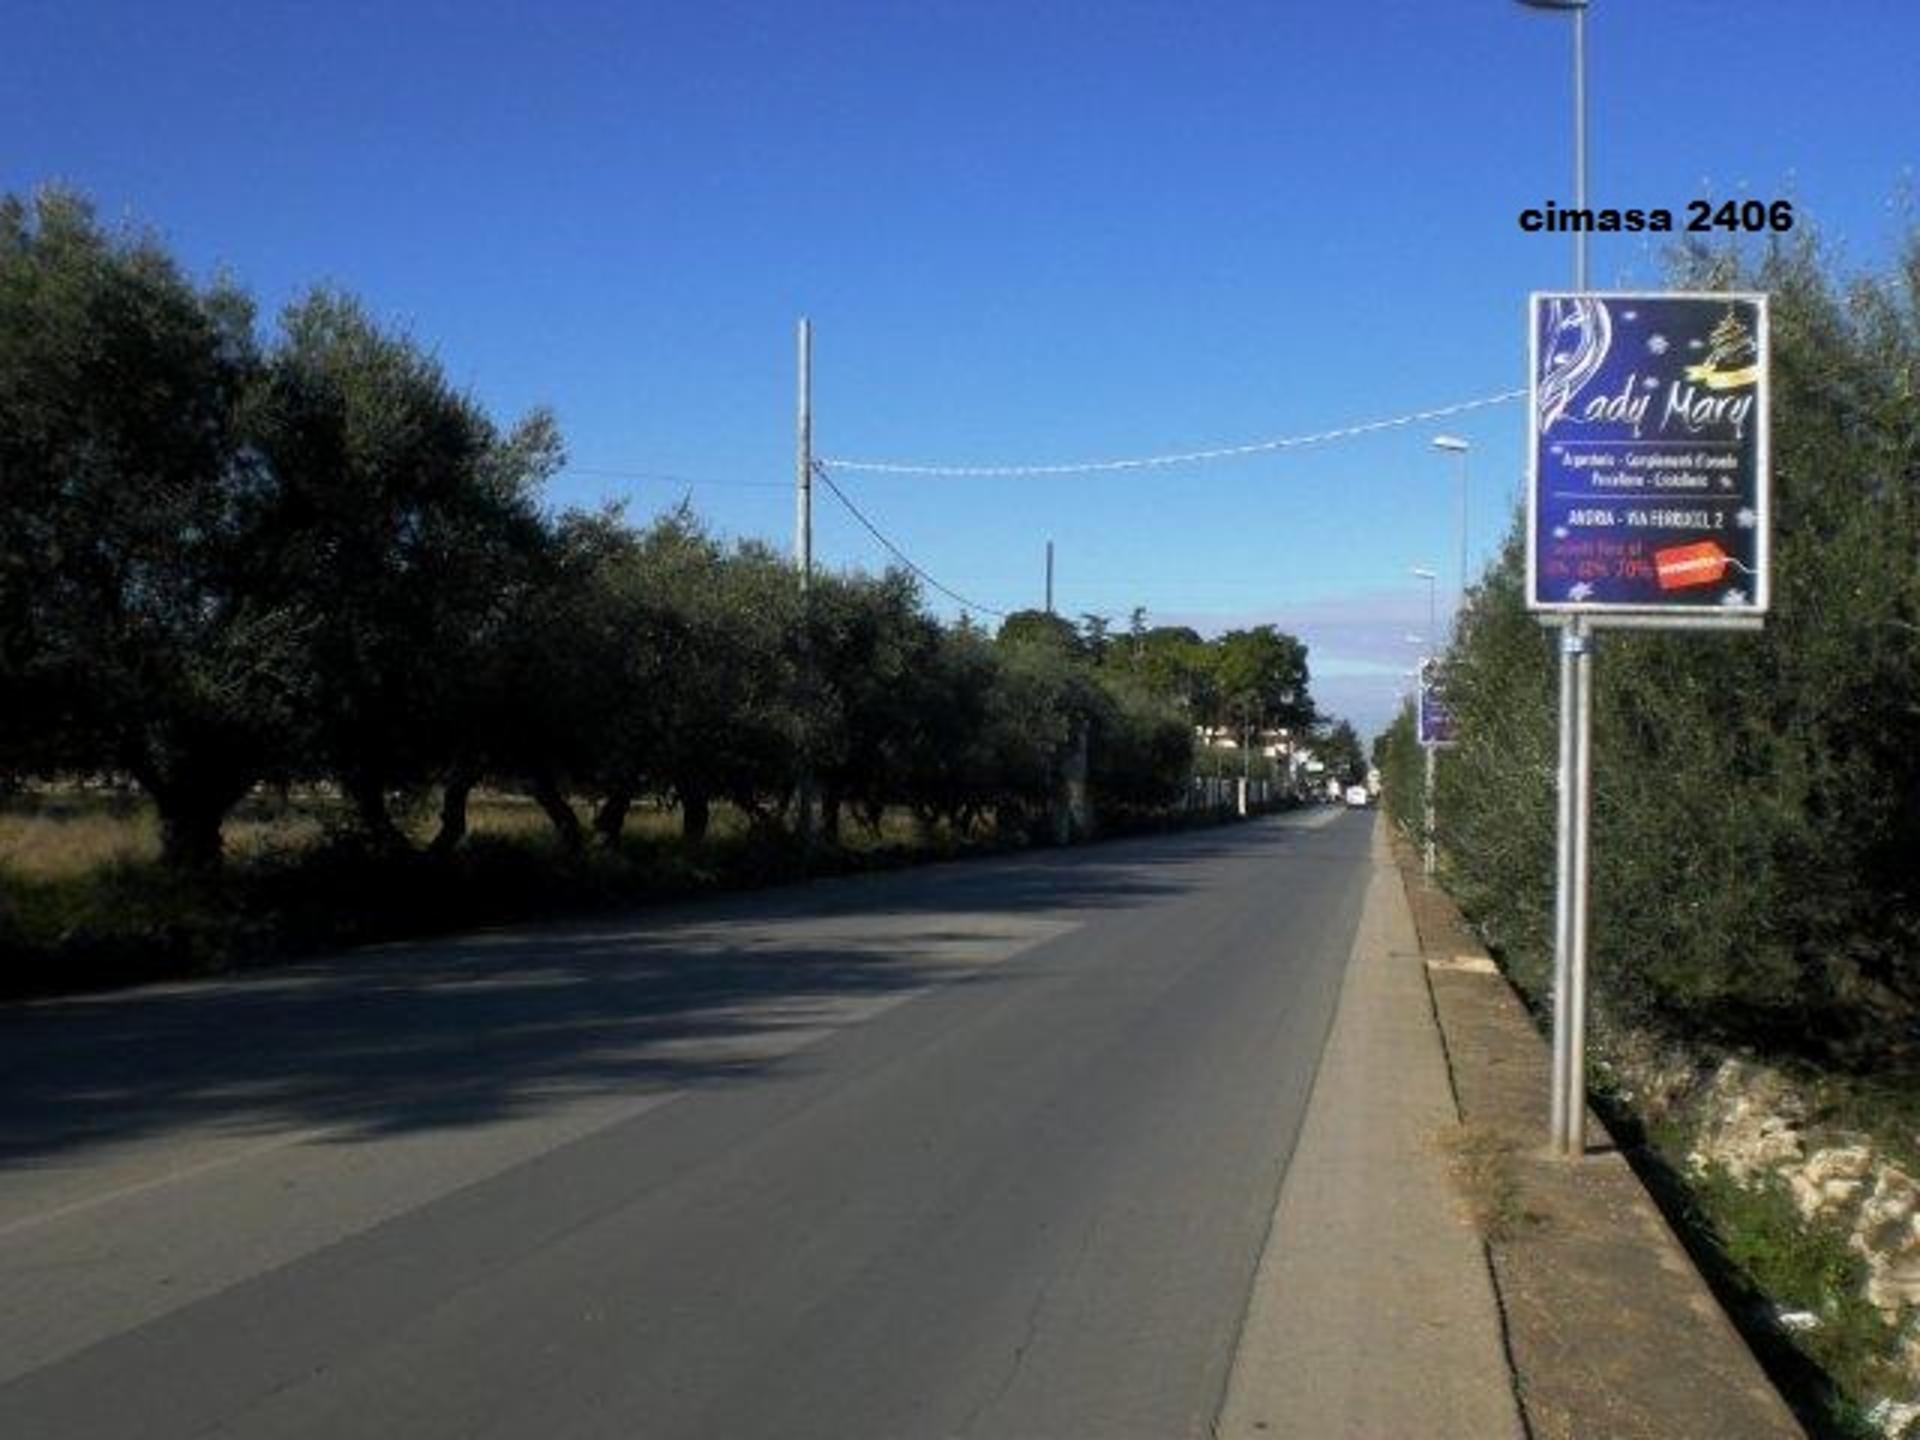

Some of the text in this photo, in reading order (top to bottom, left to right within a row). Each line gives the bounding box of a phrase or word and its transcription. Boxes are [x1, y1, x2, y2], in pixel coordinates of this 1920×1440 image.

[1543, 373, 1753, 439] Lady Mary
[1569, 509, 1615, 526] ANDRIA
